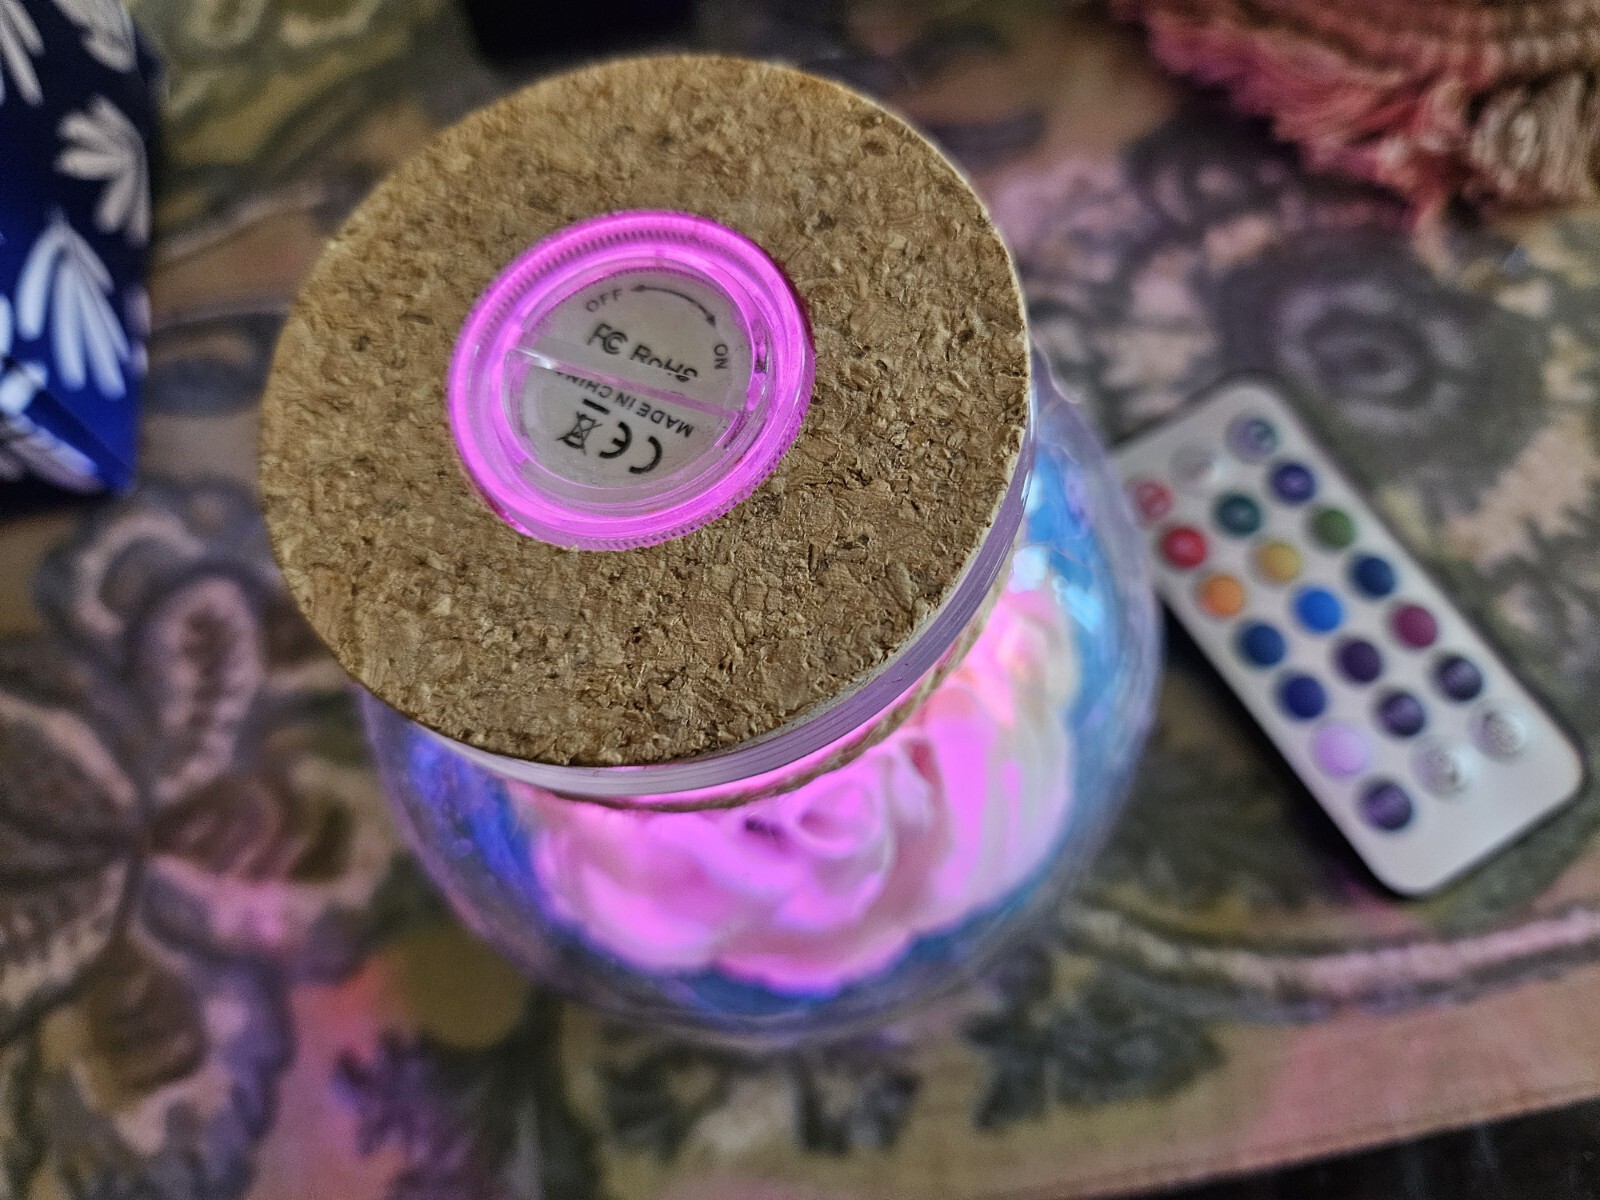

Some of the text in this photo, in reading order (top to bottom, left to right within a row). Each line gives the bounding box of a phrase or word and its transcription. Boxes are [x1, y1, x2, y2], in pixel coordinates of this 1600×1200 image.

[586, 289, 622, 312] OFF
[587, 323, 628, 355] FC
[714, 343, 728, 370] ON
[556, 371, 693, 437] MADE IN CHIN
[598, 421, 663, 474] CE
